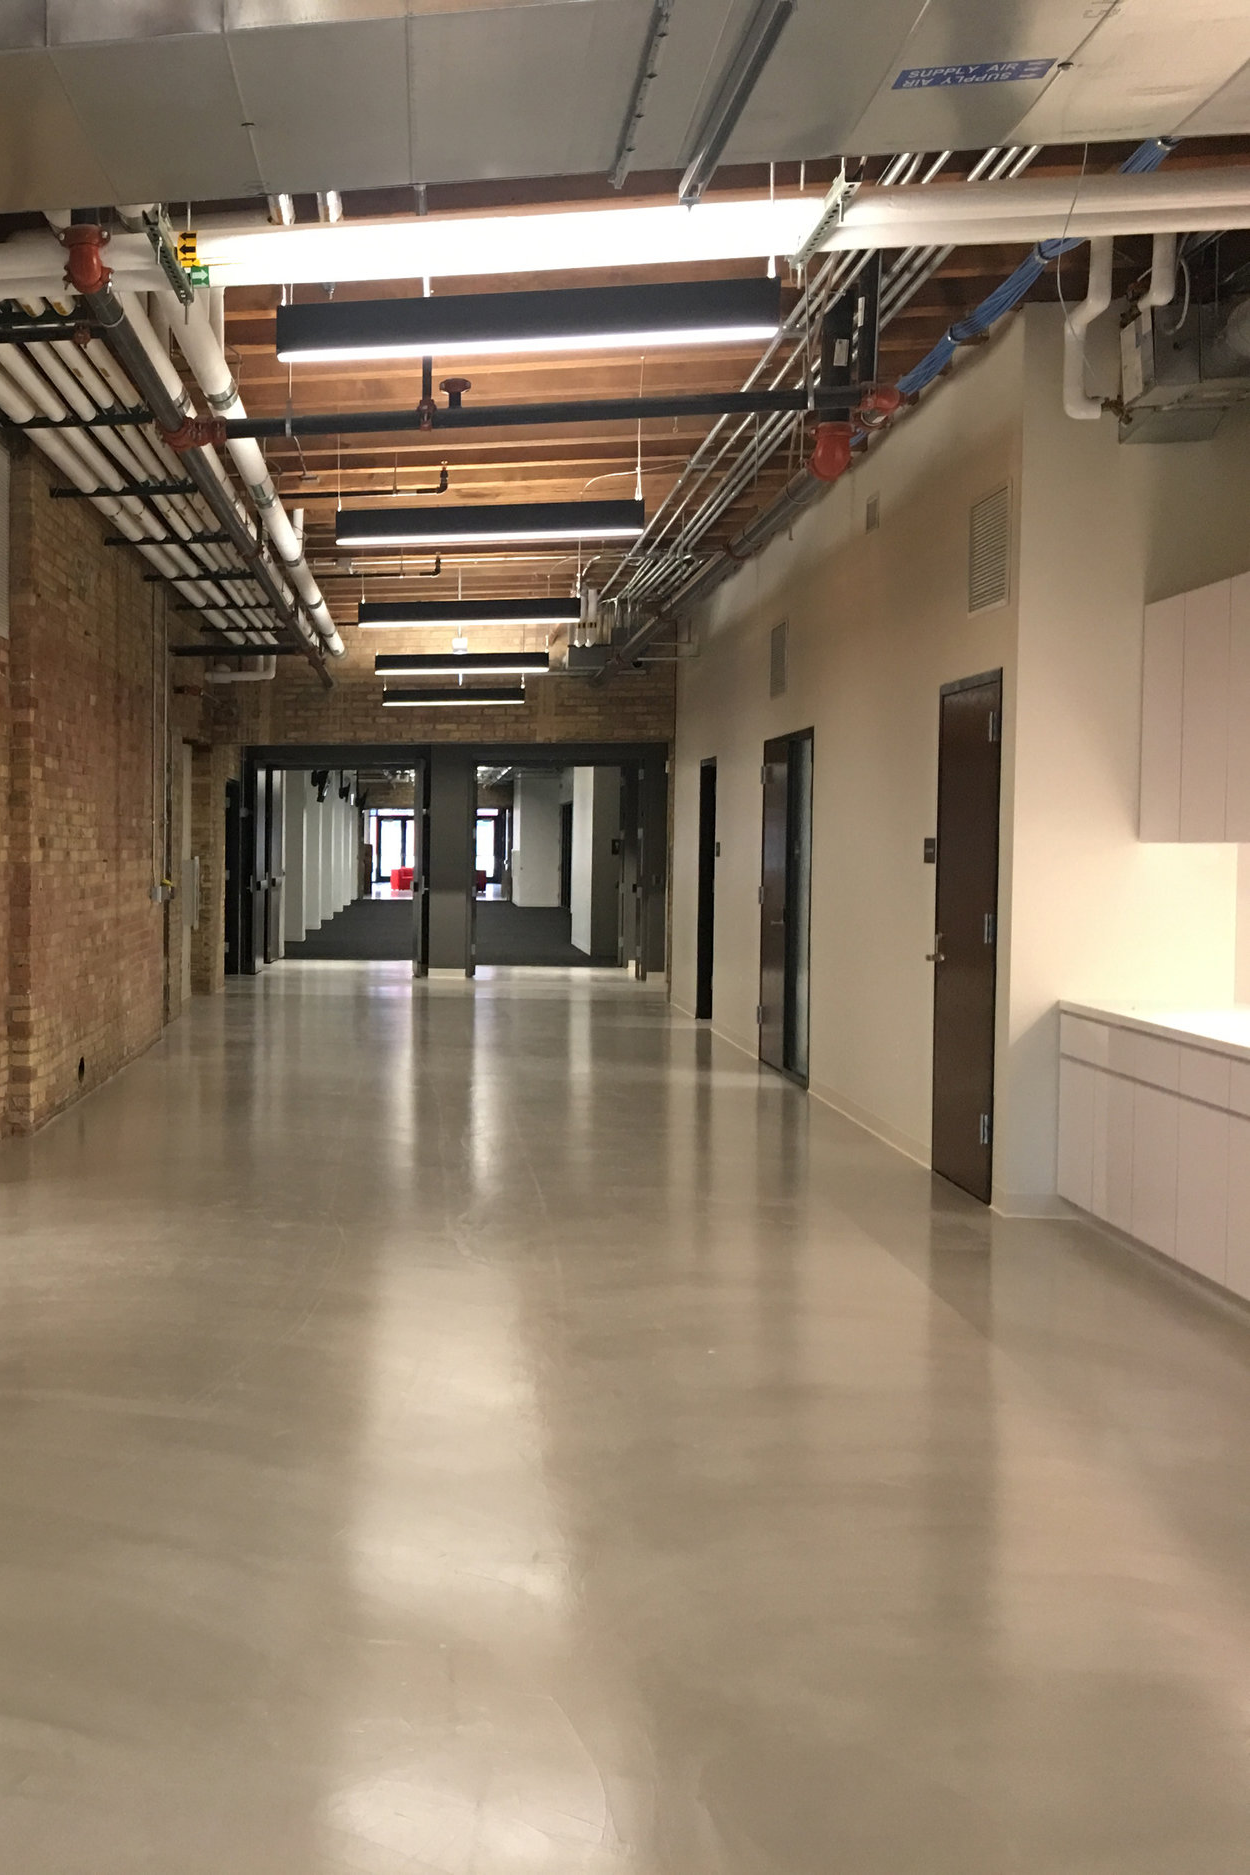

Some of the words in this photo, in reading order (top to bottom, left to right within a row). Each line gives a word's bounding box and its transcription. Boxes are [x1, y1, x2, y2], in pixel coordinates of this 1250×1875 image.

[908, 66, 980, 78] SUPPLY
[986, 62, 1019, 73] AIR
[902, 78, 934, 88] AIR
[941, 72, 1012, 84] SUPPLY
